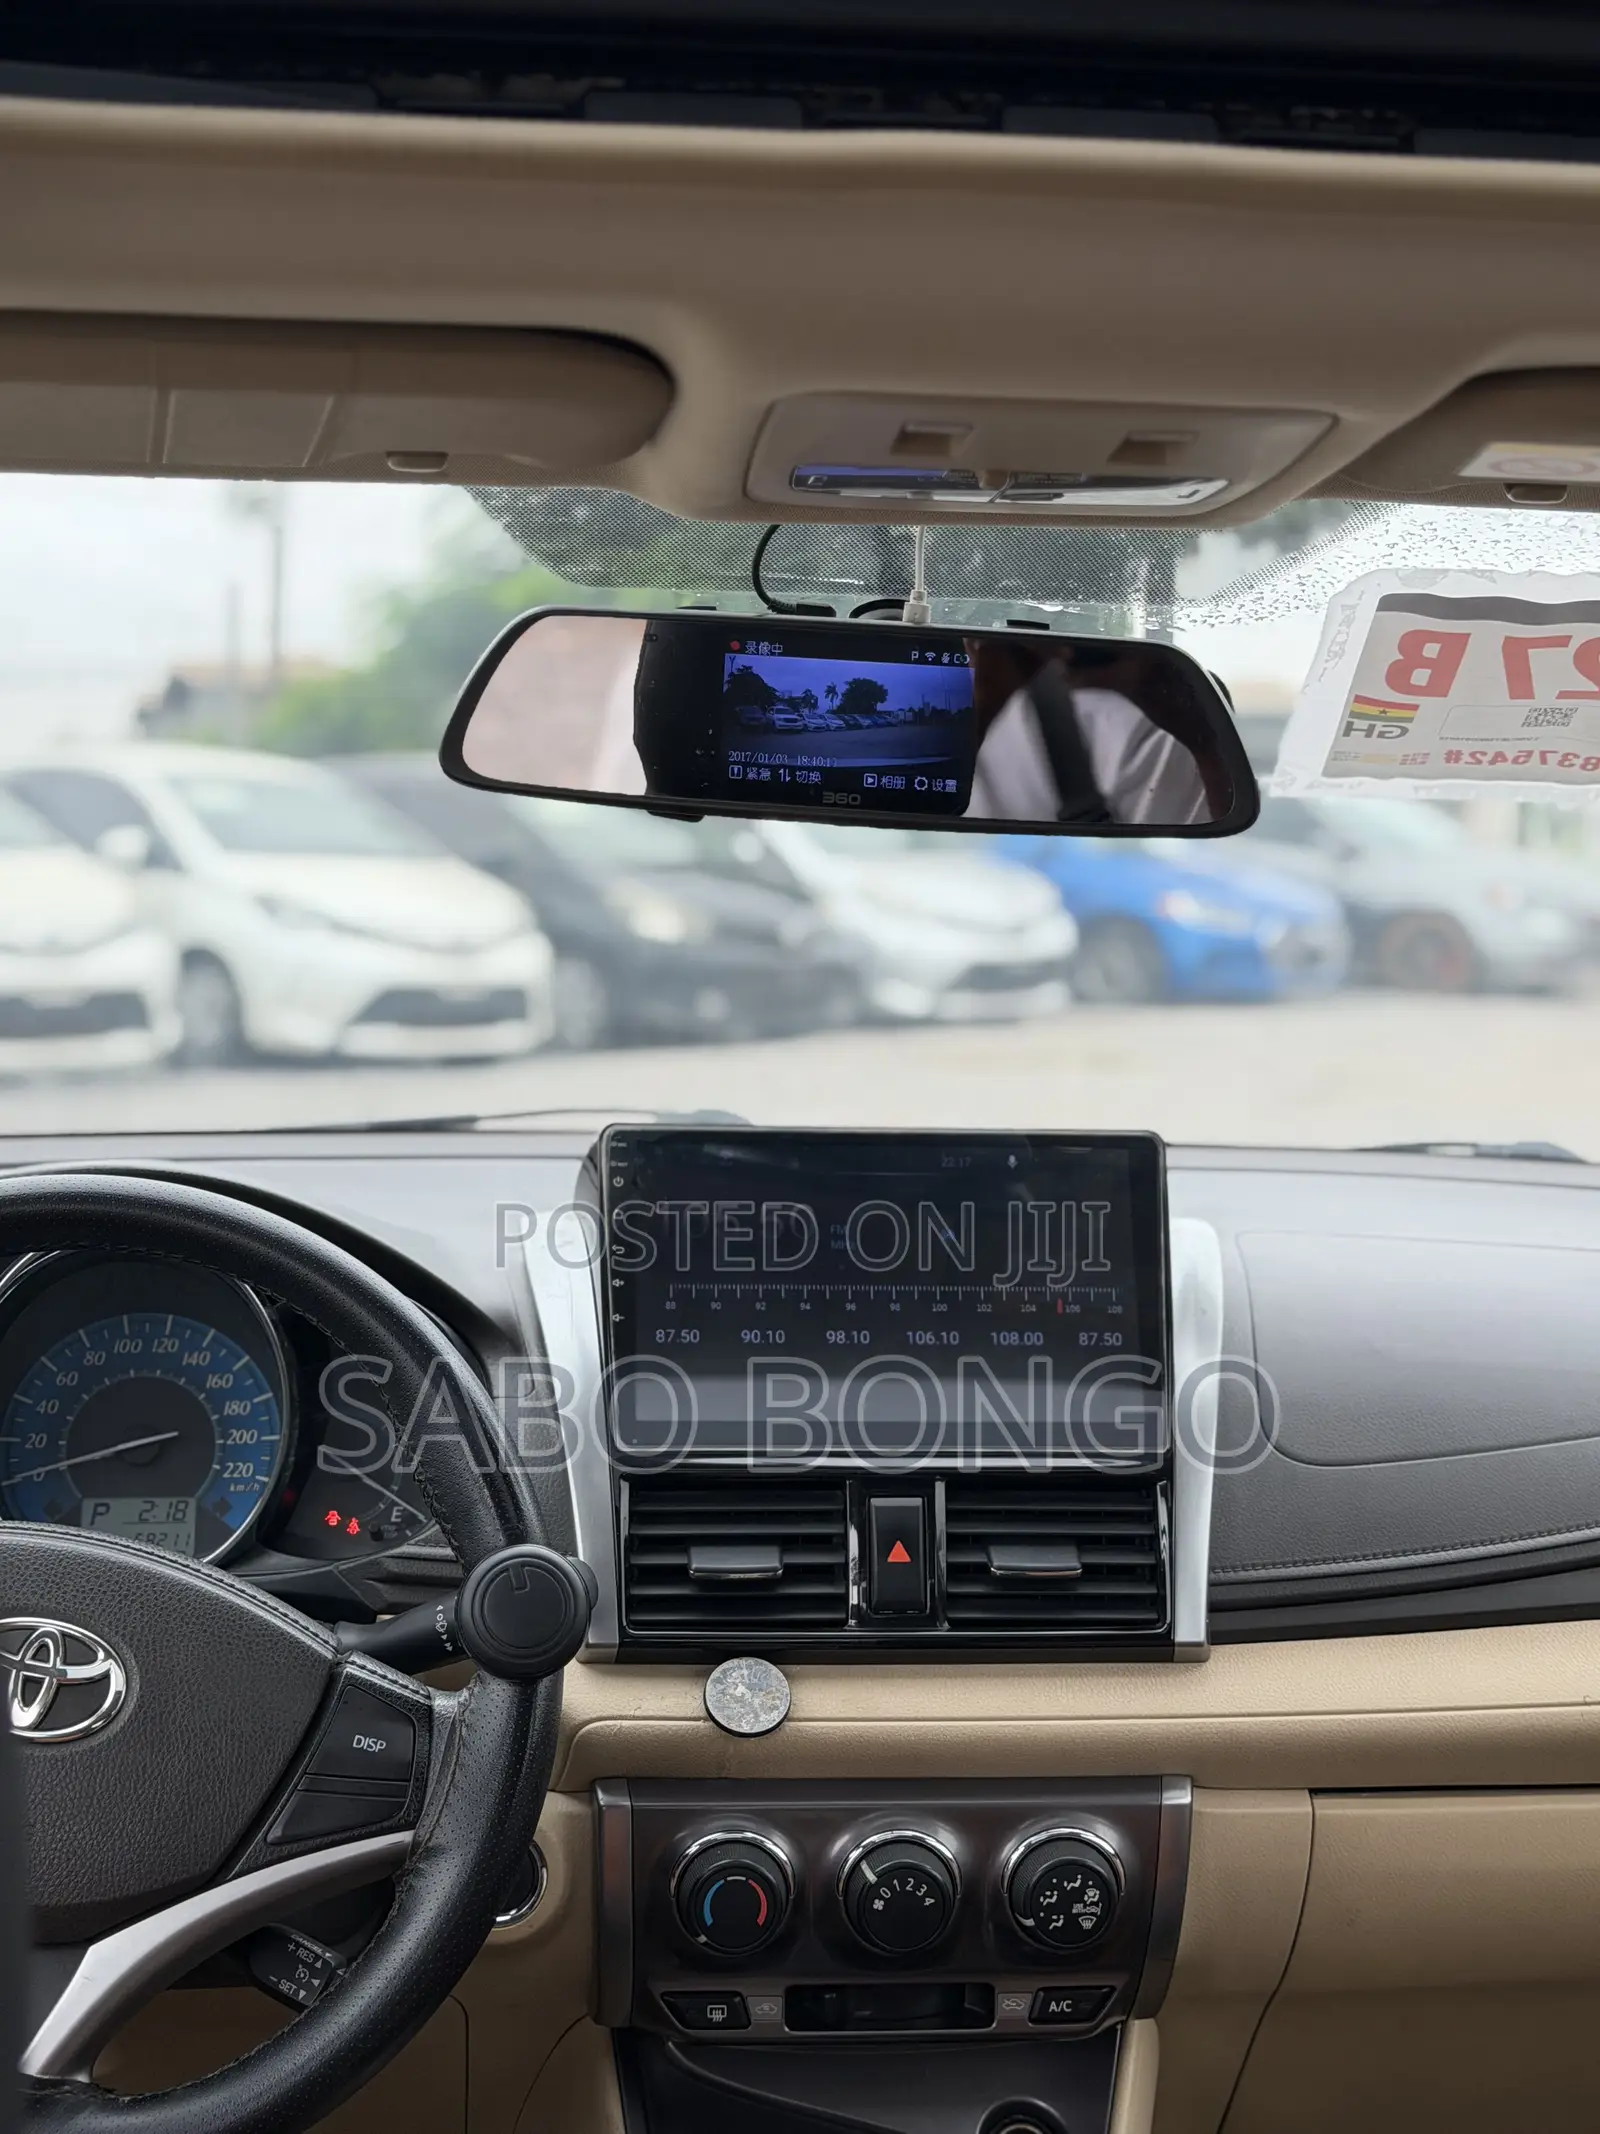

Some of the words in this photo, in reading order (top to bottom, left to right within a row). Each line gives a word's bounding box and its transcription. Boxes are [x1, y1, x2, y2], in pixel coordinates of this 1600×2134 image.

[745, 641, 783, 656] 录像中
[728, 750, 788, 764] 2017/01/03
[746, 767, 771, 781] 紧急
[795, 770, 821, 784] 切换
[880, 775, 905, 789] 相册
[932, 778, 957, 792] 设置
[822, 791, 861, 805] 360
[665, 1302, 676, 1311] 88
[711, 1302, 722, 1311] 90
[755, 1302, 767, 1311] 92
[800, 1302, 811, 1311] 94
[845, 1303, 856, 1312] 96
[890, 1303, 901, 1312] 98
[932, 1303, 948, 1312] 100
[976, 1304, 993, 1313] 102
[1021, 1304, 1037, 1313] 104
[1065, 1304, 1081, 1313] 106
[1107, 1305, 1123, 1314] 108
[152, 1338, 179, 1352] 120
[655, 1329, 700, 1344] 87.50
[741, 1330, 786, 1344] 90.10
[826, 1330, 871, 1345] 98.10
[906, 1331, 960, 1346] 106.10
[990, 1332, 1044, 1346] 108.00
[1078, 1332, 1123, 1346] 87.50
[113, 1338, 143, 1354] 100
[83, 1350, 106, 1366] 80
[182, 1351, 210, 1366] 140
[56, 1371, 78, 1386] 60
[206, 1373, 233, 1388] 160
[36, 1399, 59, 1414] 40
[223, 1400, 251, 1416] 180
[25, 1433, 47, 1448] 20
[226, 1429, 257, 1444] 200
[223, 1462, 253, 1478] 220
[229, 1482, 260, 1492] km/h
[90, 1502, 111, 1526] P
[139, 1500, 189, 1522] 2:18
[391, 1506, 404, 1522] E
[352, 1734, 387, 1753] DISP
[893, 1879, 900, 1891] 1
[905, 1877, 915, 1891] 2
[915, 1883, 927, 1896] 3
[880, 1887, 891, 1898] 0
[923, 1897, 935, 1906] 4
[291, 1934, 323, 1955] CANCEL
[296, 1947, 315, 1963] RES
[278, 1979, 298, 1995] SET
[1048, 1999, 1073, 2013] A/C
